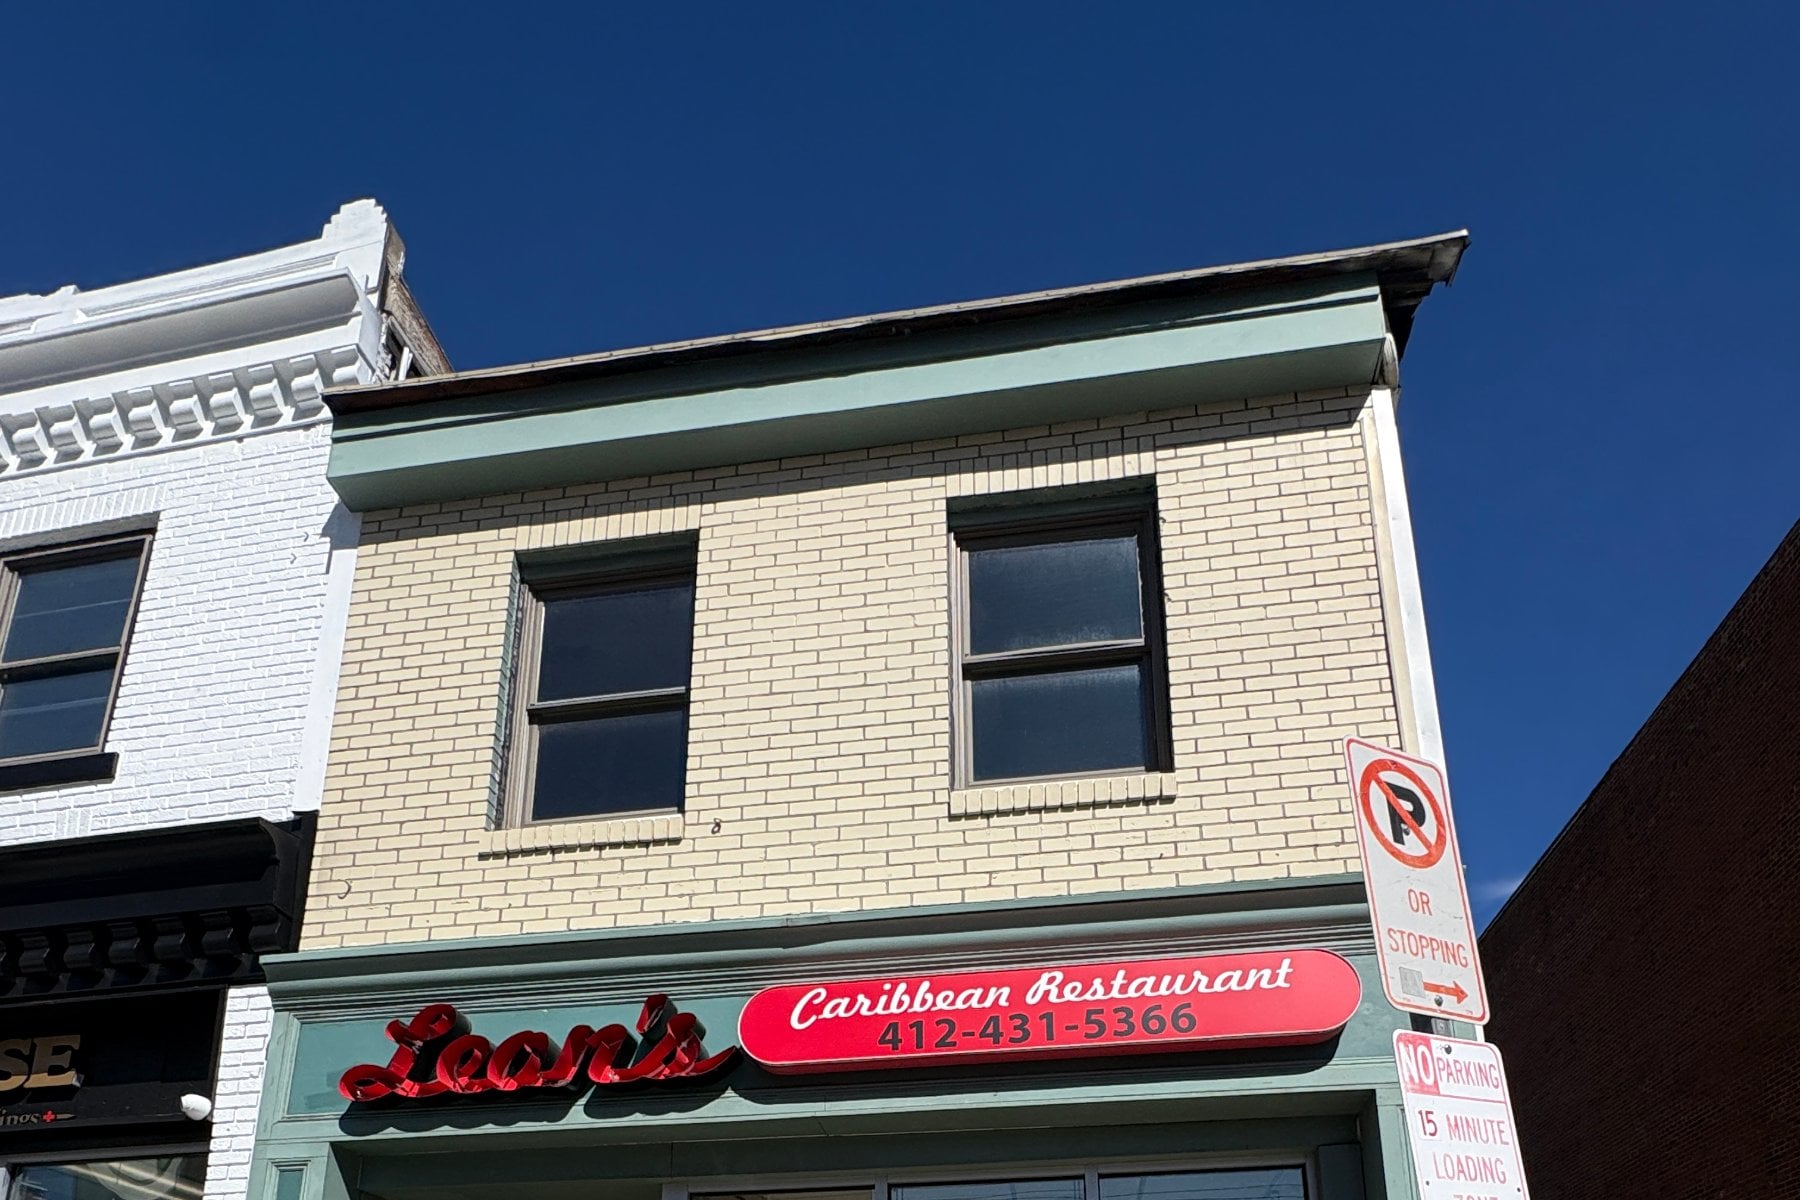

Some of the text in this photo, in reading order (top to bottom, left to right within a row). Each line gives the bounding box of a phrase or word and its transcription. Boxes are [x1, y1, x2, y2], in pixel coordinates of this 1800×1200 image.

[1407, 888, 1432, 916] OR
[1387, 928, 1469, 968] STOPPING
[790, 958, 1294, 1030] Caribbean Restaurant
[877, 1002, 1198, 1051] 412-431-5366
[1398, 1041, 1500, 1089] NO PARKING
[1418, 1110, 1510, 1145] 15 MINUTE
[1433, 1151, 1507, 1184] LOADING
